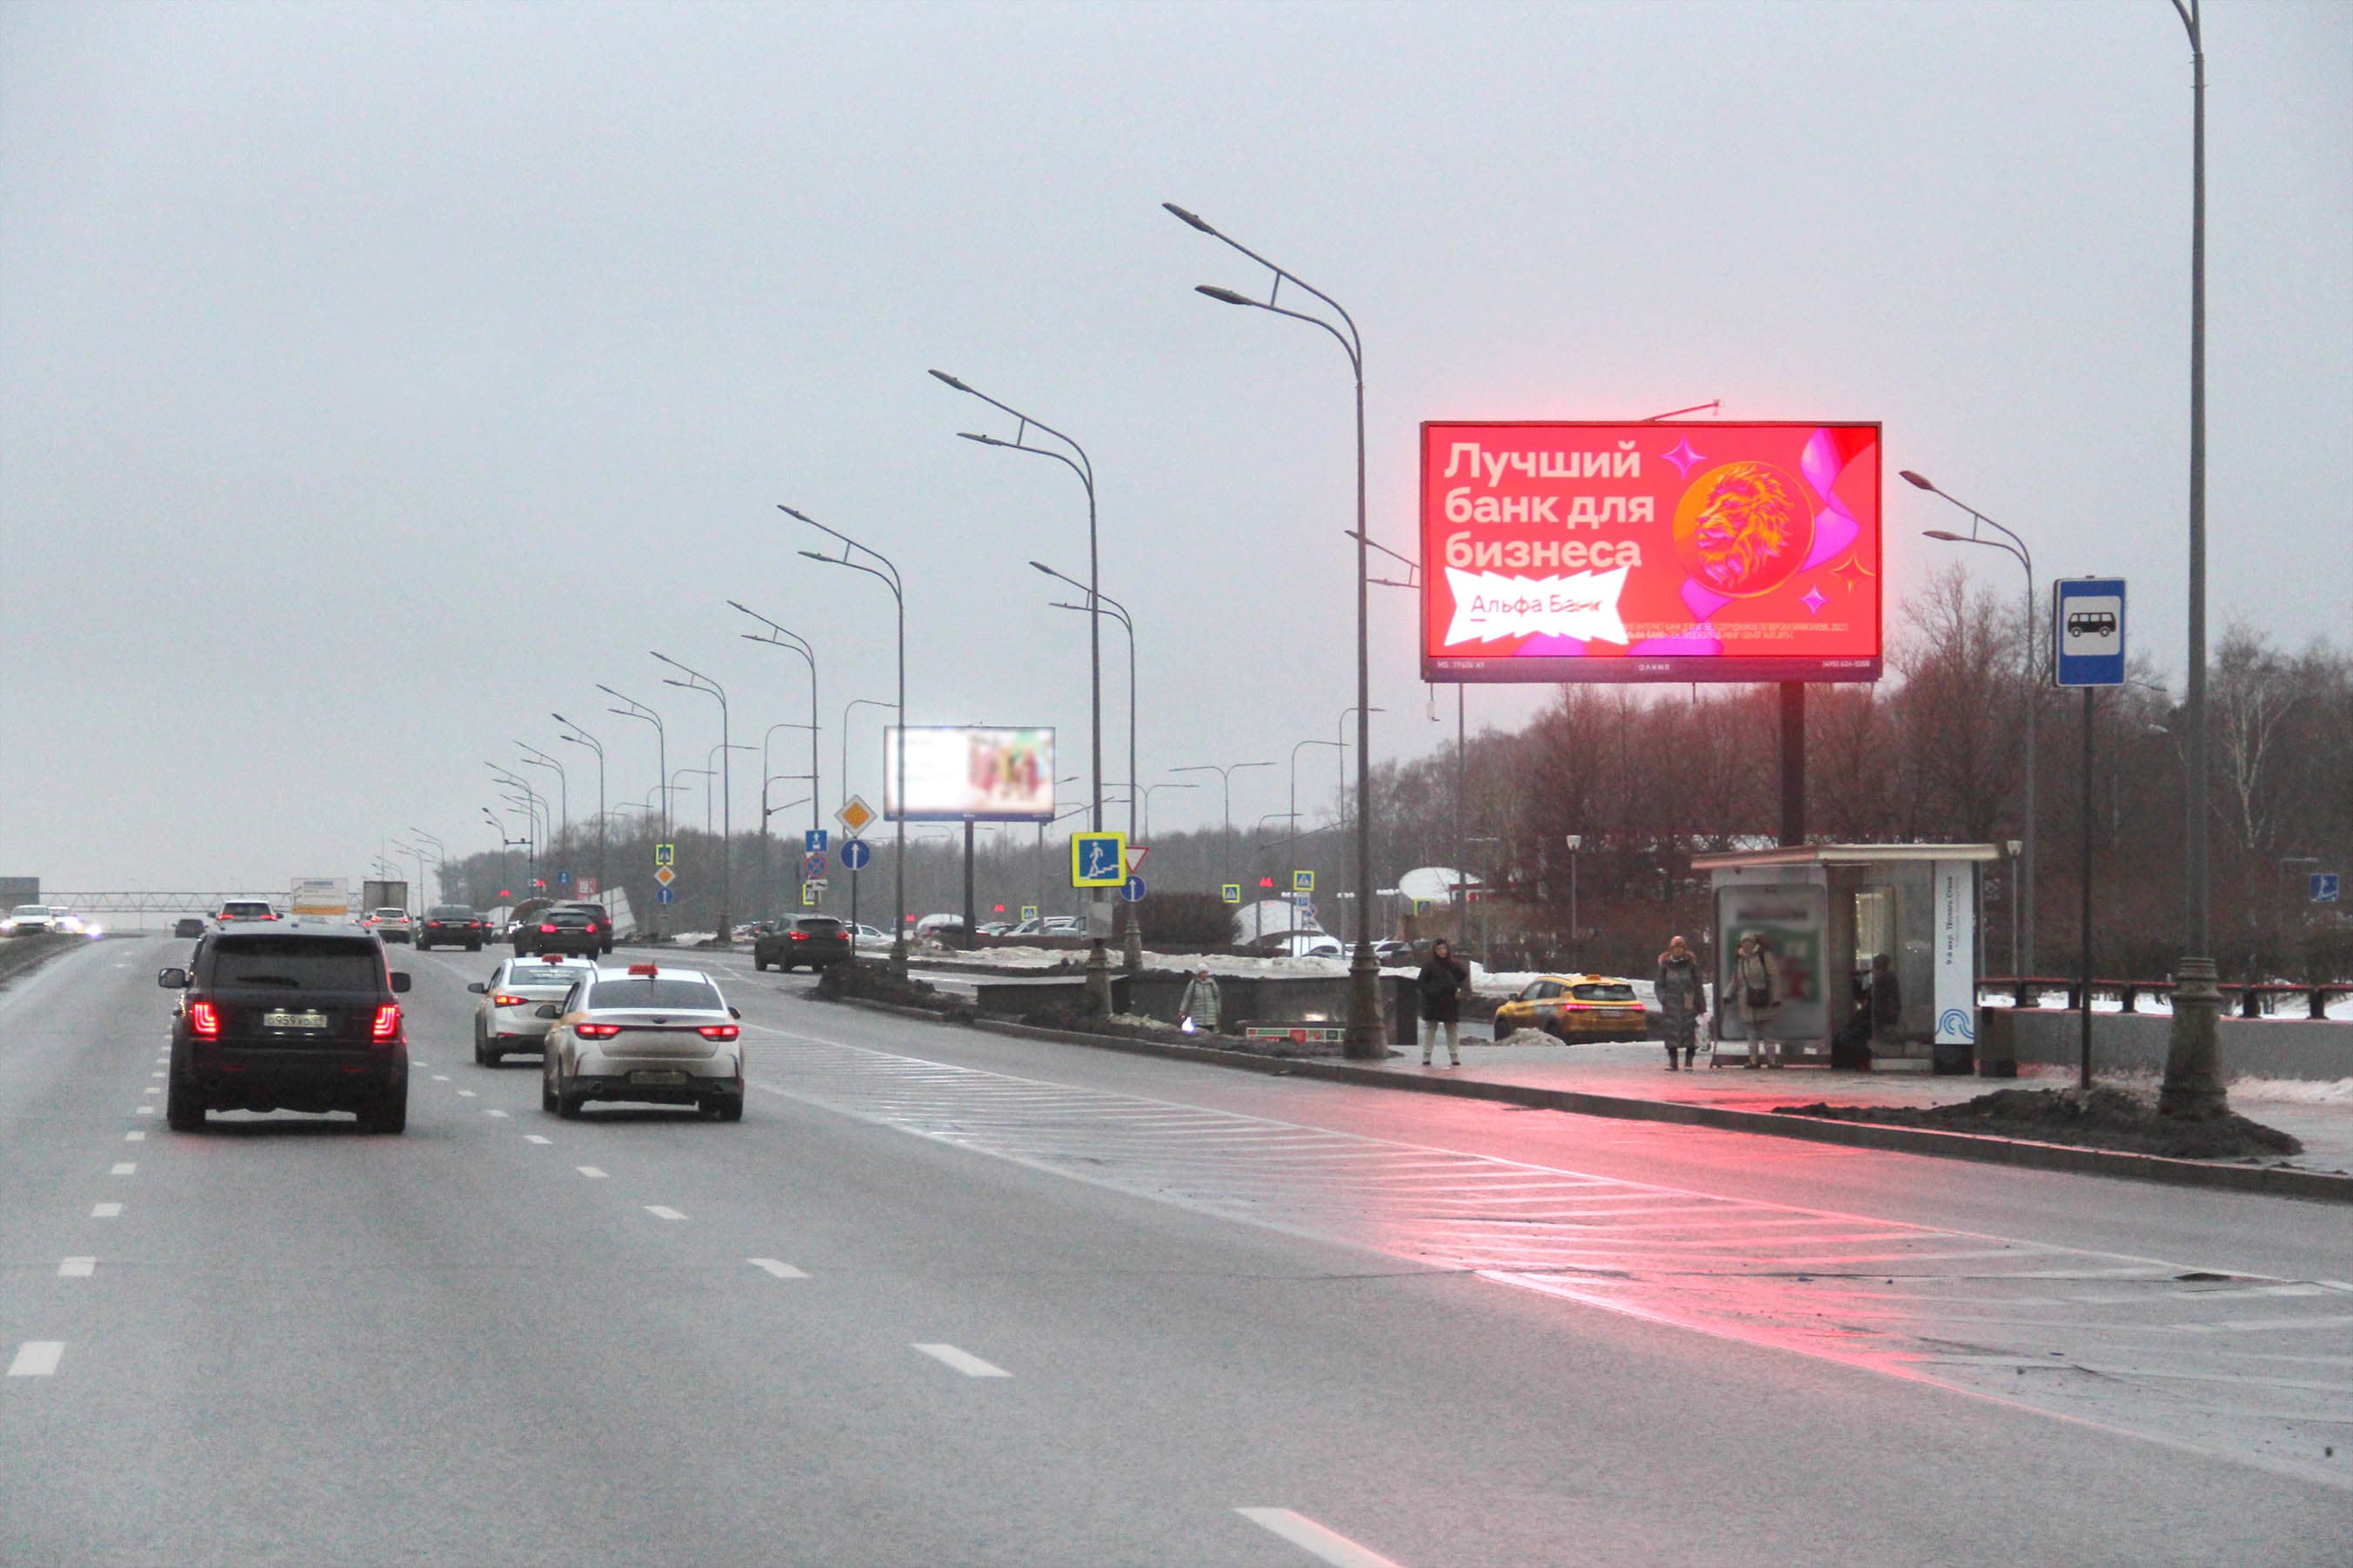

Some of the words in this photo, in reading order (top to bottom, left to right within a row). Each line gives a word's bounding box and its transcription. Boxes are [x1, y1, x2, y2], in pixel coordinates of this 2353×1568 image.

[1444, 440, 1641, 488] Лучший
[1445, 486, 1560, 524] банк
[1568, 496, 1654, 530] для
[1445, 530, 1642, 567] бизнеса
[1470, 594, 1542, 617] Альфа
